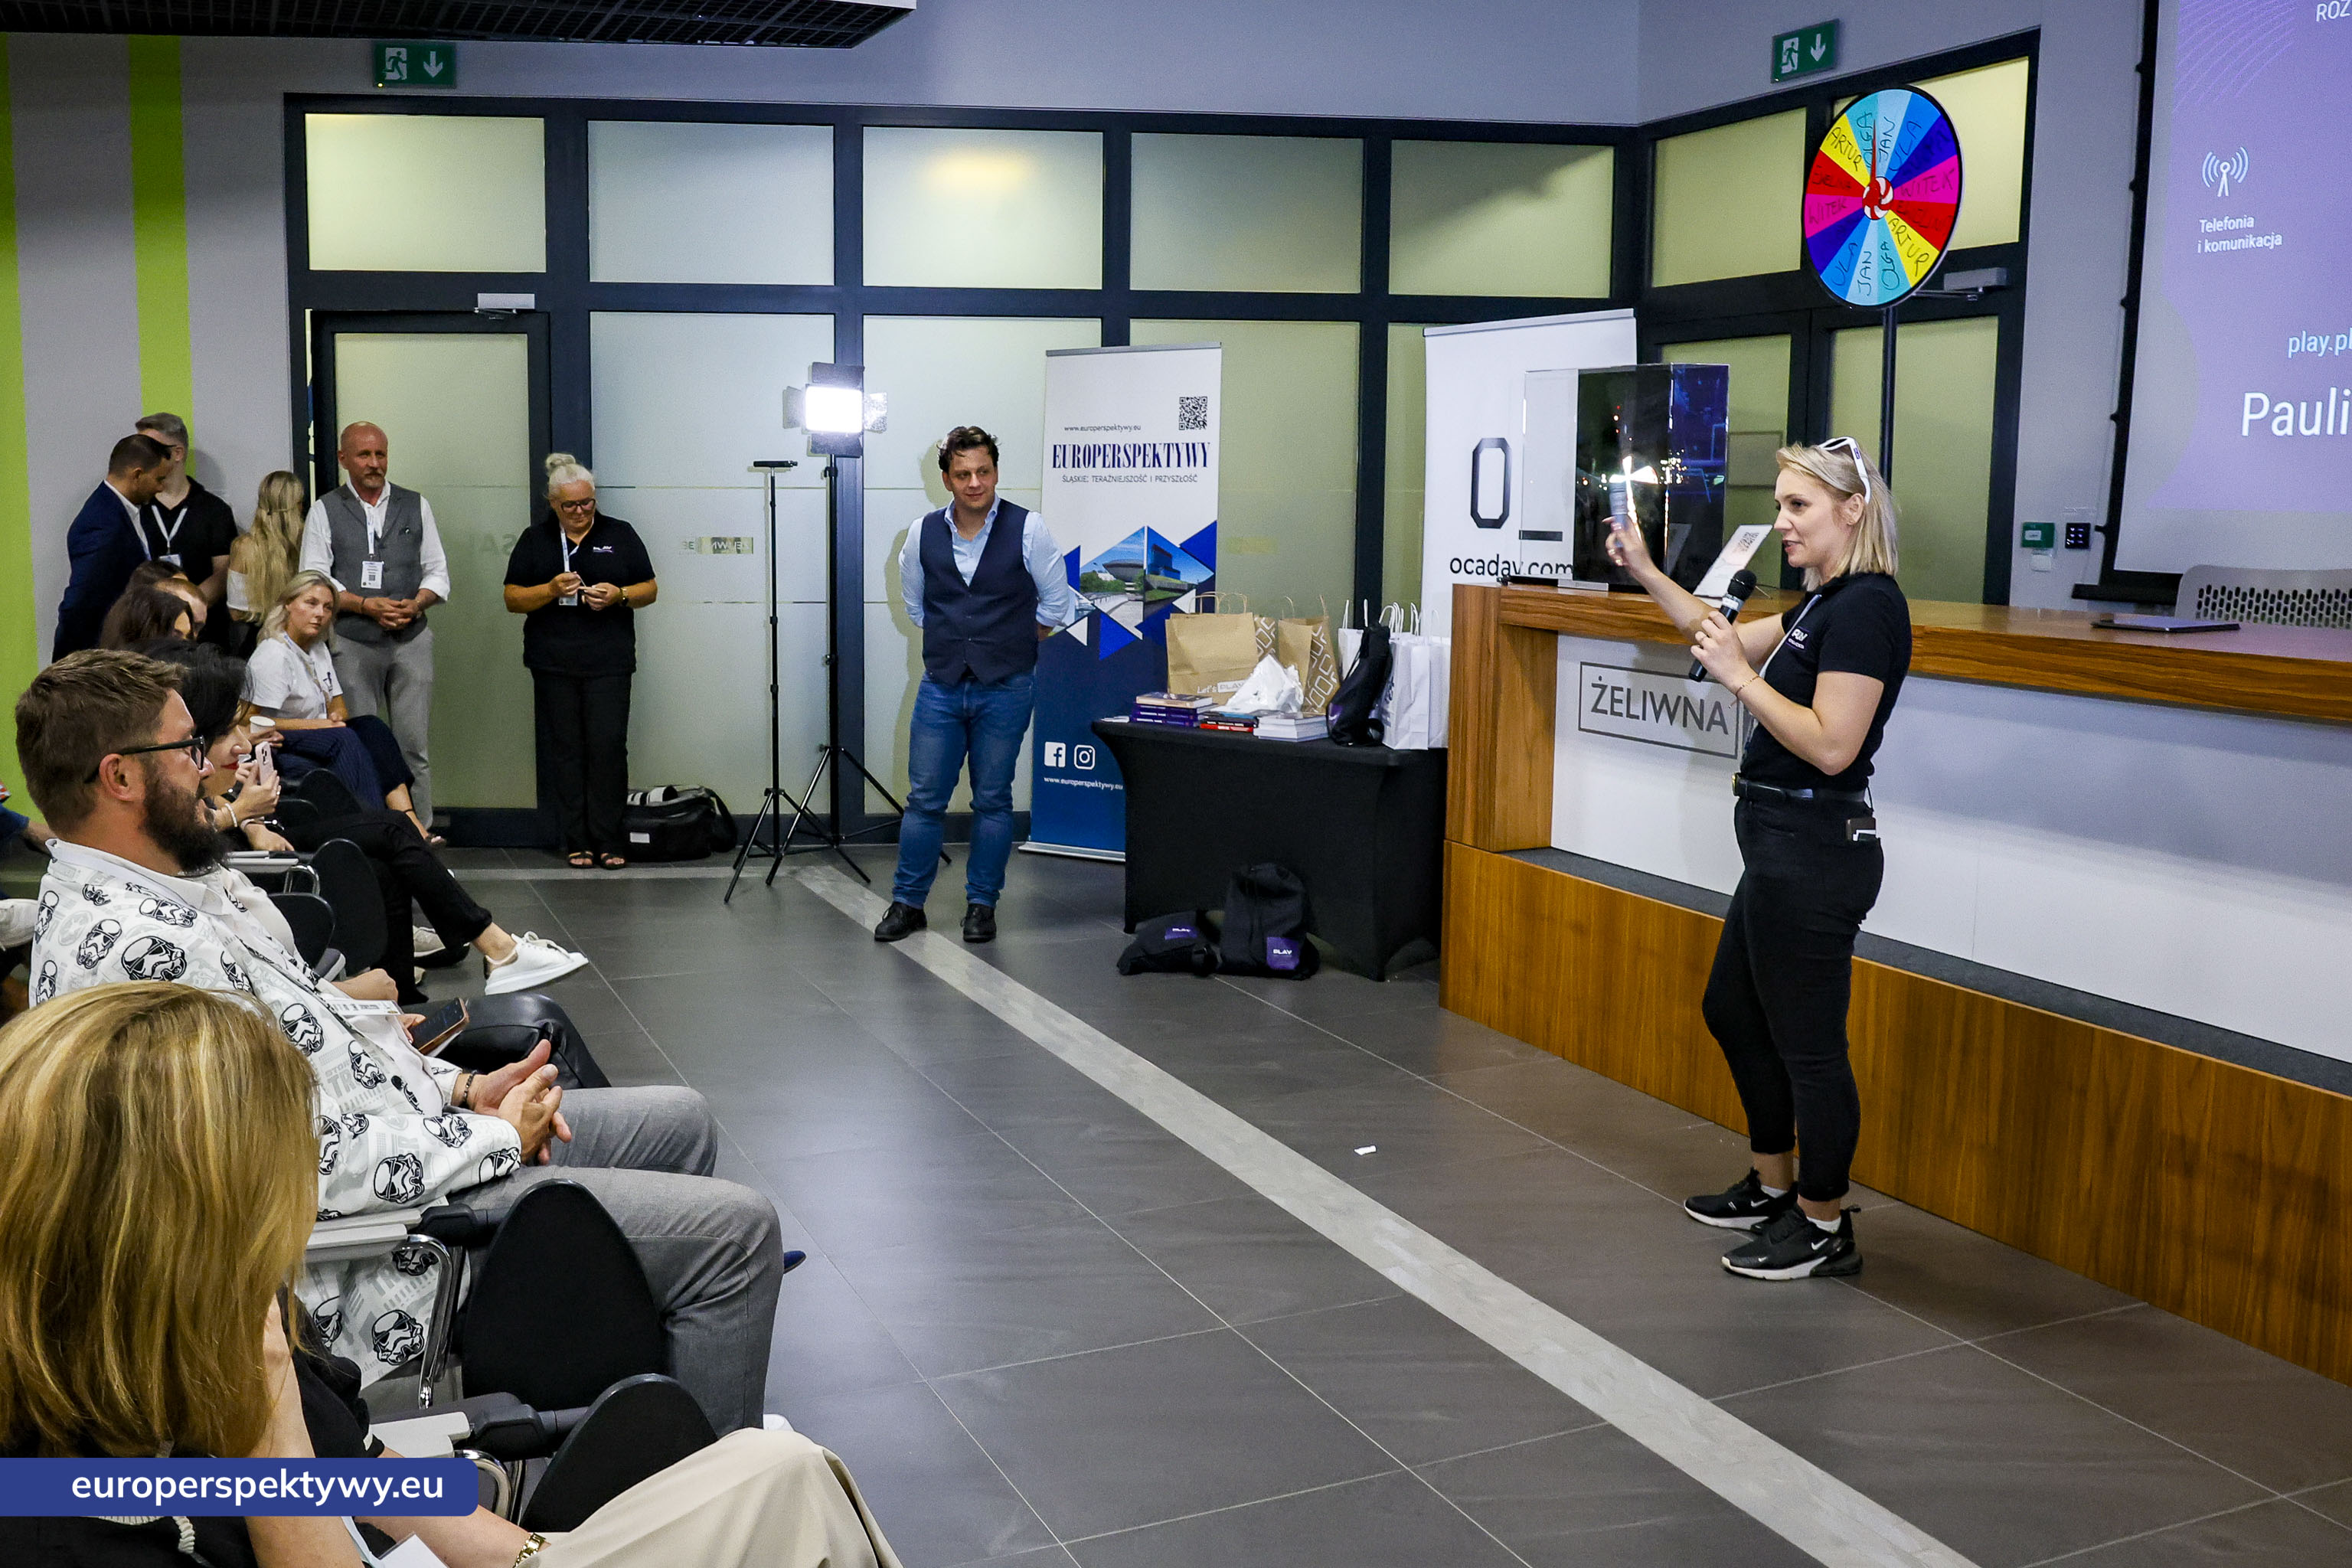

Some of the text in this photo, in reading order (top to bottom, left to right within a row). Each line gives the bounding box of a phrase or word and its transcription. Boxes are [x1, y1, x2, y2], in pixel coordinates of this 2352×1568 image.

[1826, 126, 1864, 172] ARTUR
[1878, 116, 1896, 163] JAN
[1889, 121, 1922, 172] ULA
[1900, 169, 1955, 198] WITEK
[1808, 201, 1847, 225] WITEK
[2199, 215, 2255, 234] Telefonia
[1831, 243, 1858, 286] ULA
[1888, 217, 1930, 276] ARTUR
[2197, 233, 2283, 253] i komunikacja
[1857, 250, 1873, 296] JAN
[1880, 240, 1900, 290] OLGA
[2288, 327, 2352, 359] play.pl
[1064, 423, 1142, 433] www.europerspektywy.eu
[2241, 387, 2351, 437] Pauli
[1052, 442, 1210, 469] EUROPERSPEKTYWY
[1591, 675, 1729, 735] ŻELIWNA
[1044, 777, 1123, 790] www.europerspektywy.eu
